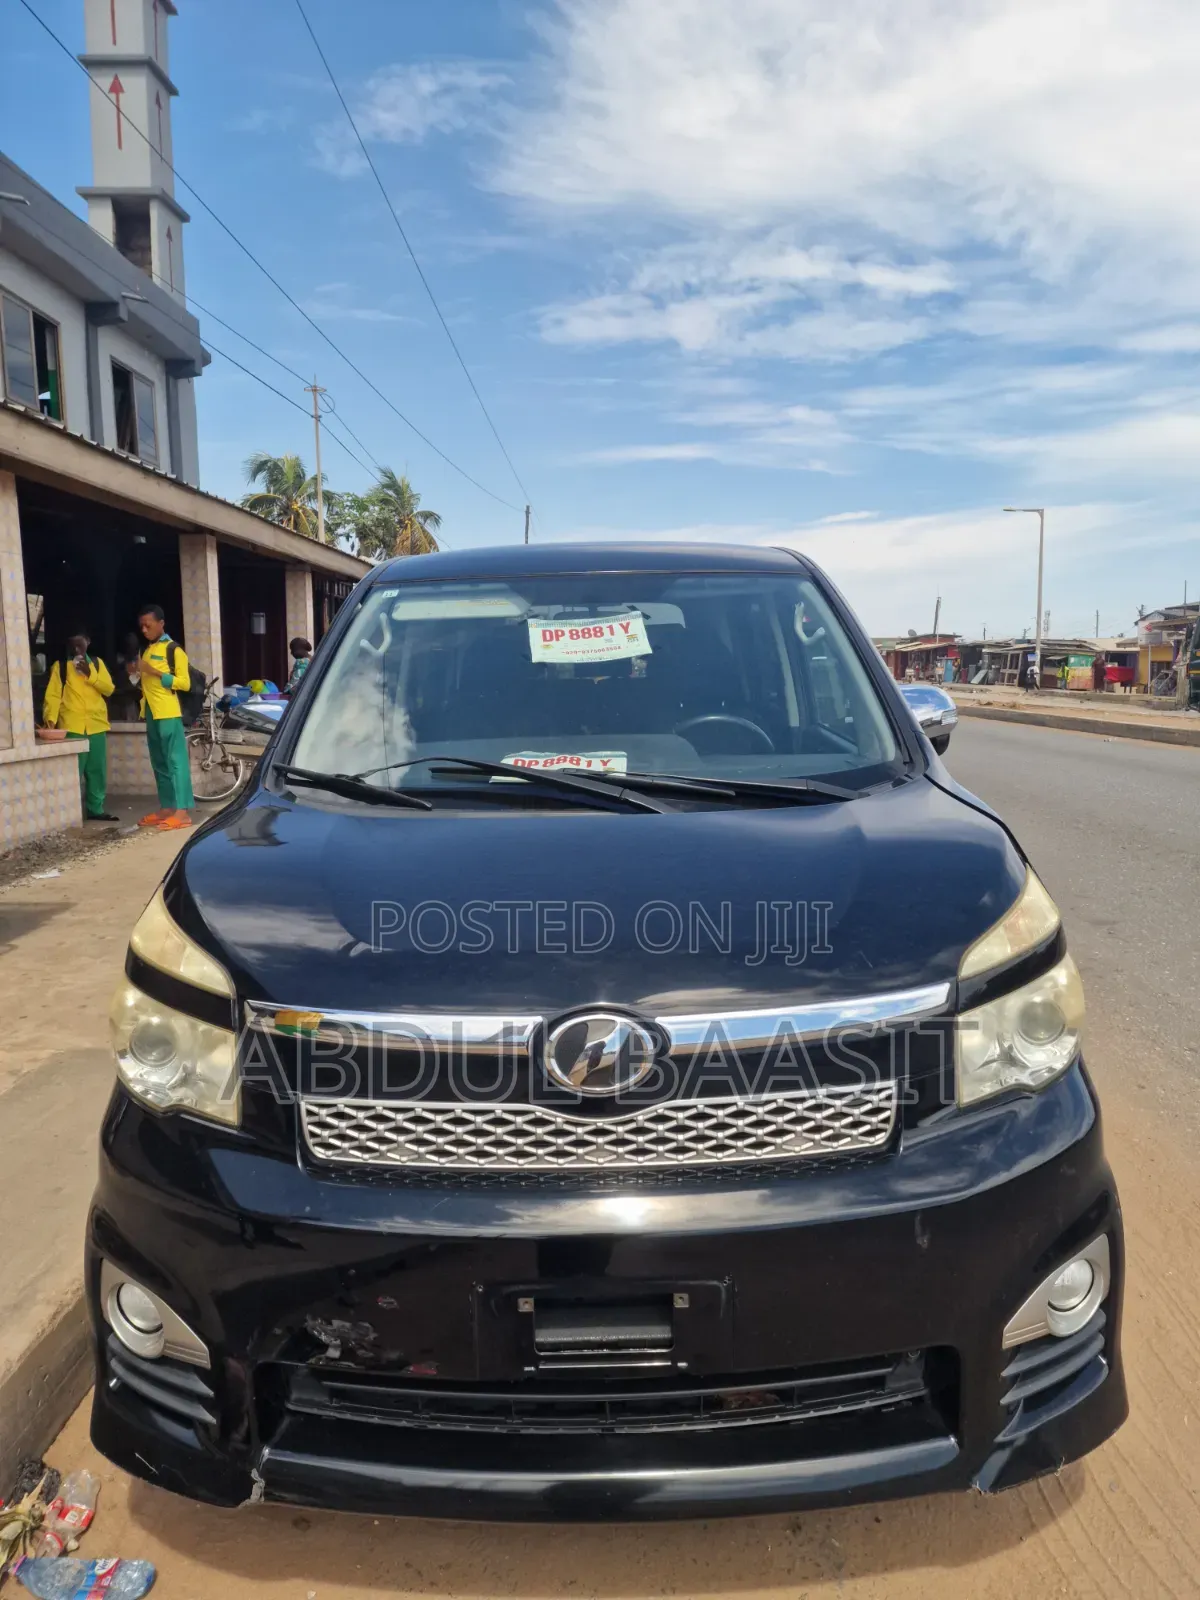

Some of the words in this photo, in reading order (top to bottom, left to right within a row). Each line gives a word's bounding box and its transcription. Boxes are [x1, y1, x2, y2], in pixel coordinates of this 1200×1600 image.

[541, 629, 565, 642] DP
[568, 624, 615, 641] 8881
[619, 621, 631, 635] Y
[513, 758, 540, 769] DP
[541, 755, 593, 769] 8881
[600, 758, 613, 767] Y
